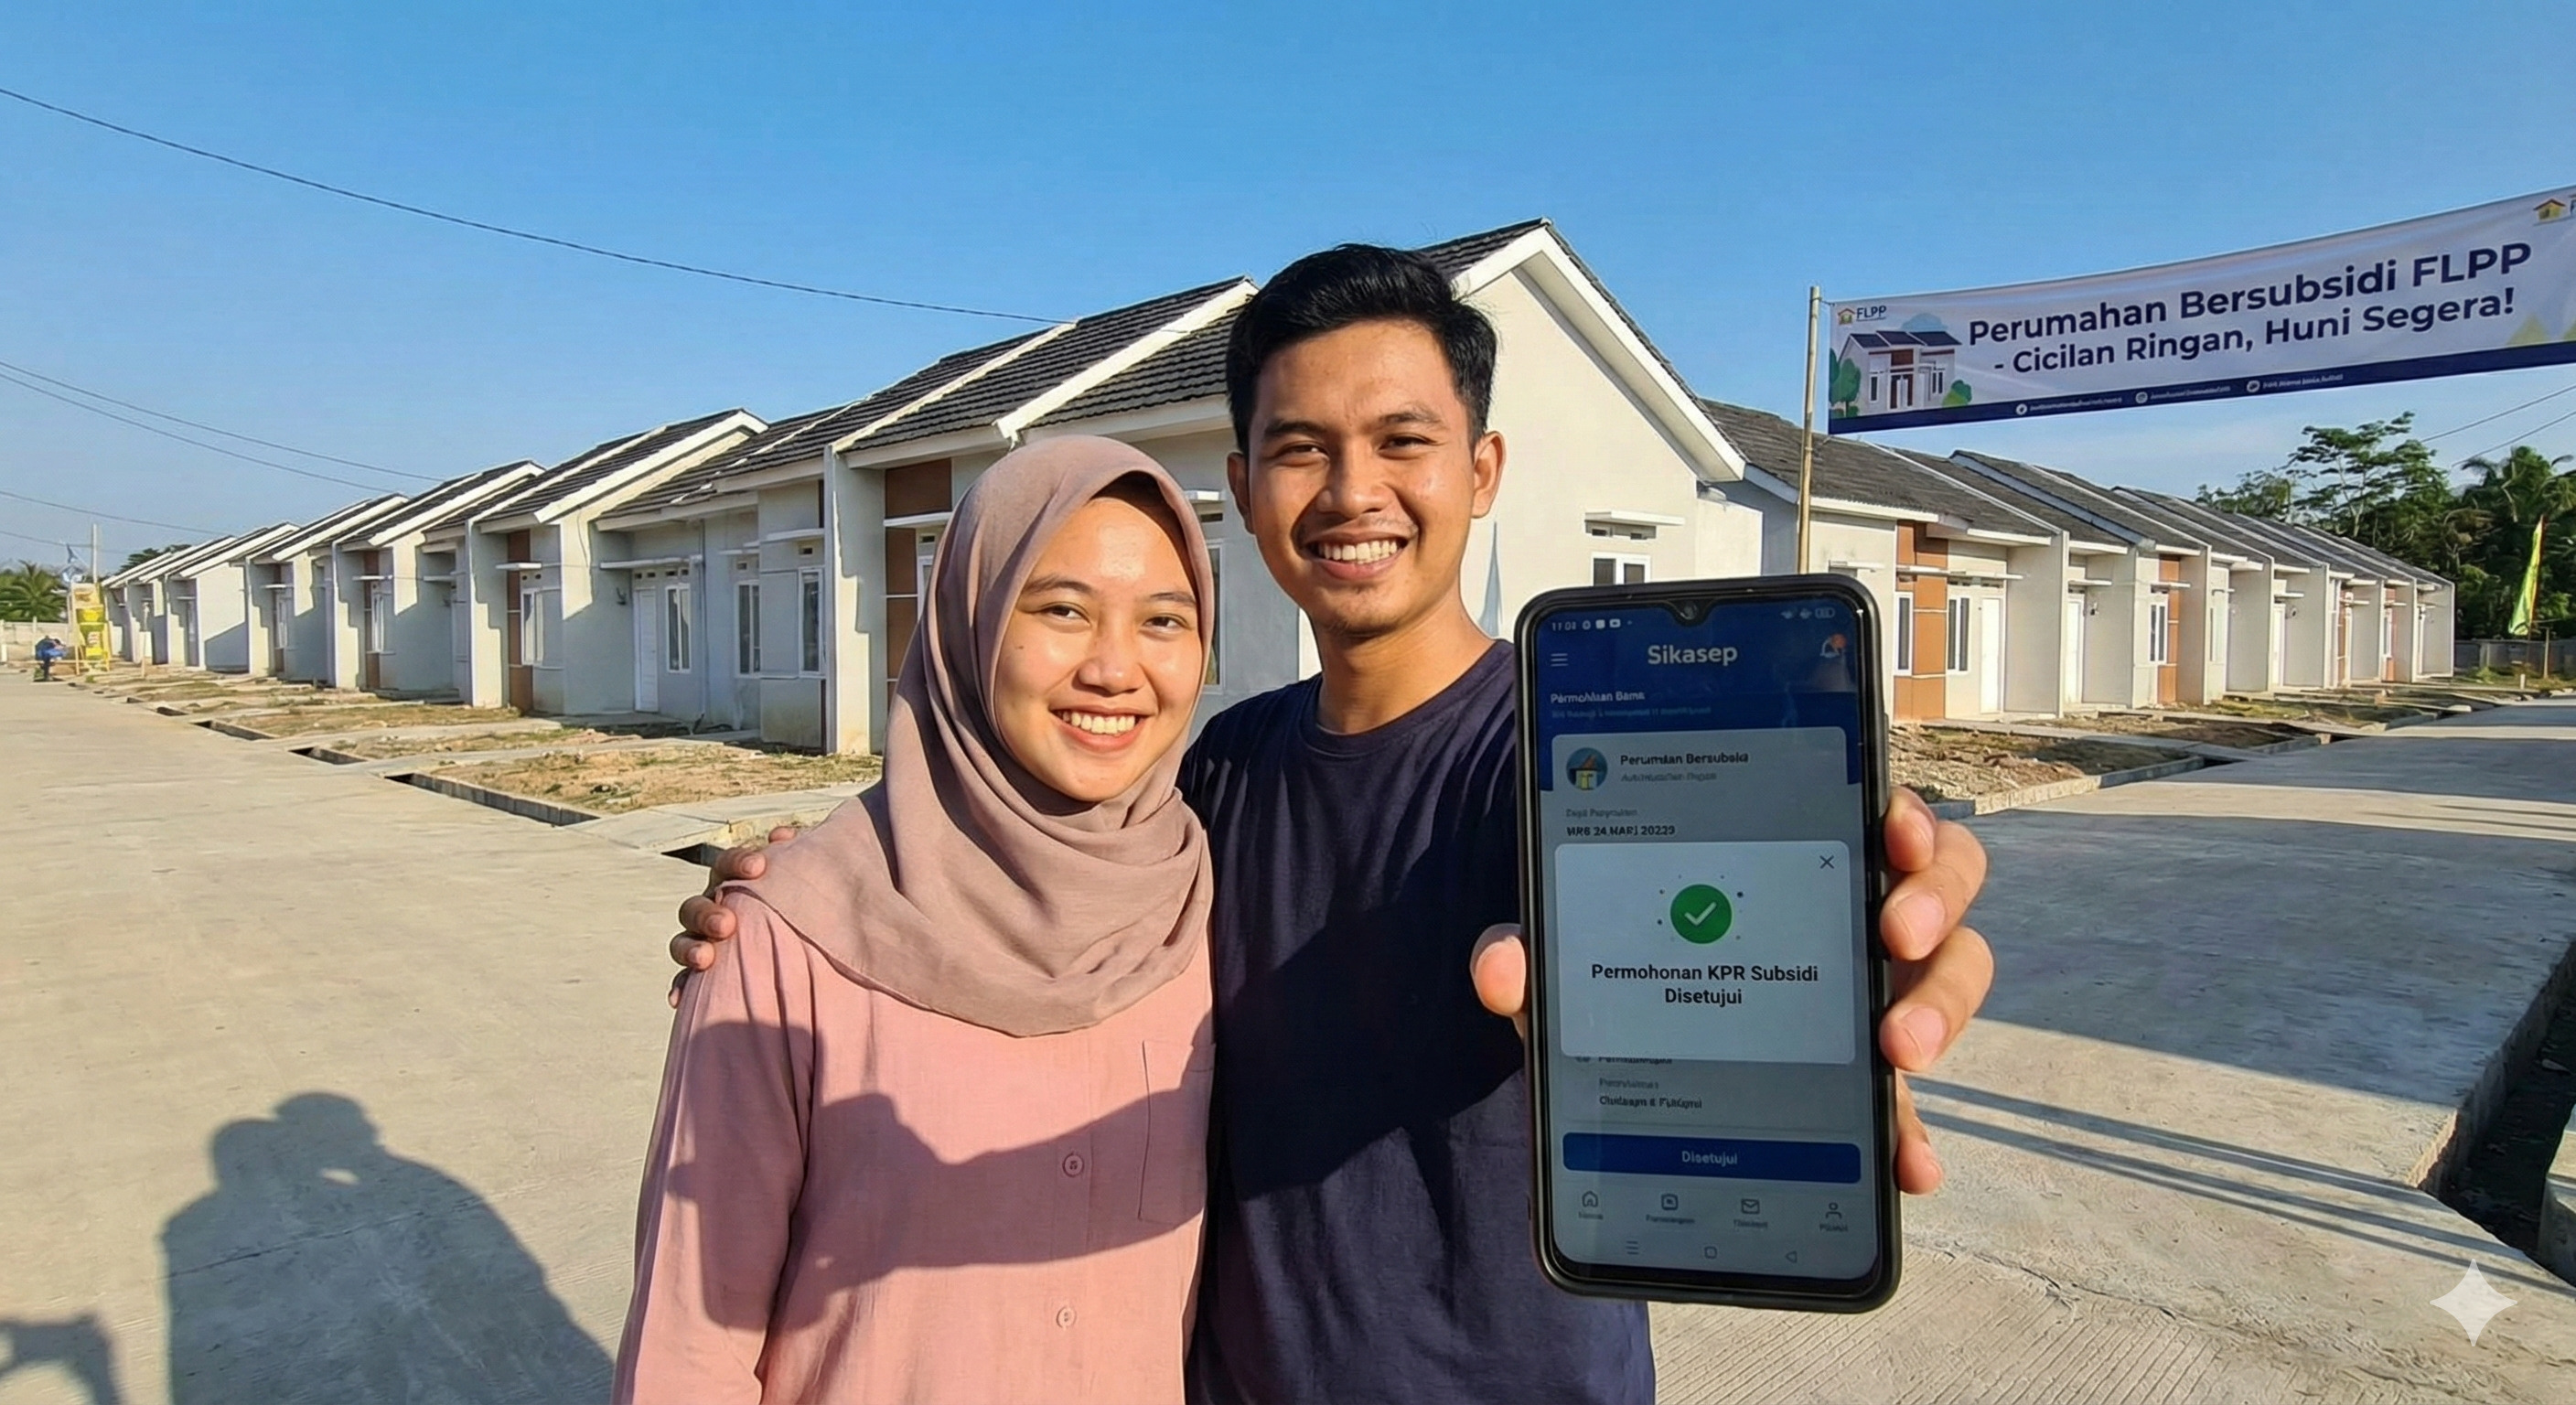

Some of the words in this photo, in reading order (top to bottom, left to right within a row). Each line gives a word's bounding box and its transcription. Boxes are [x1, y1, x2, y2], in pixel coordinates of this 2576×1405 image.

[1970, 301, 2167, 346] Perumahan
[2181, 259, 2397, 319] Bersubsidi
[2412, 242, 2532, 287] FLPP
[1856, 305, 1887, 319] FLPP
[2012, 343, 2115, 373] Cicilan
[2127, 329, 2253, 361] Ringan,
[2265, 307, 2351, 345] Huni
[2363, 286, 2515, 333] Segera!
[1648, 644, 1738, 666] Sikasep
[1591, 963, 1702, 981] Permohonan
[1707, 965, 1745, 981] KPR
[1751, 965, 1819, 982] Subsidi
[1665, 988, 1743, 1008] Disetujui
